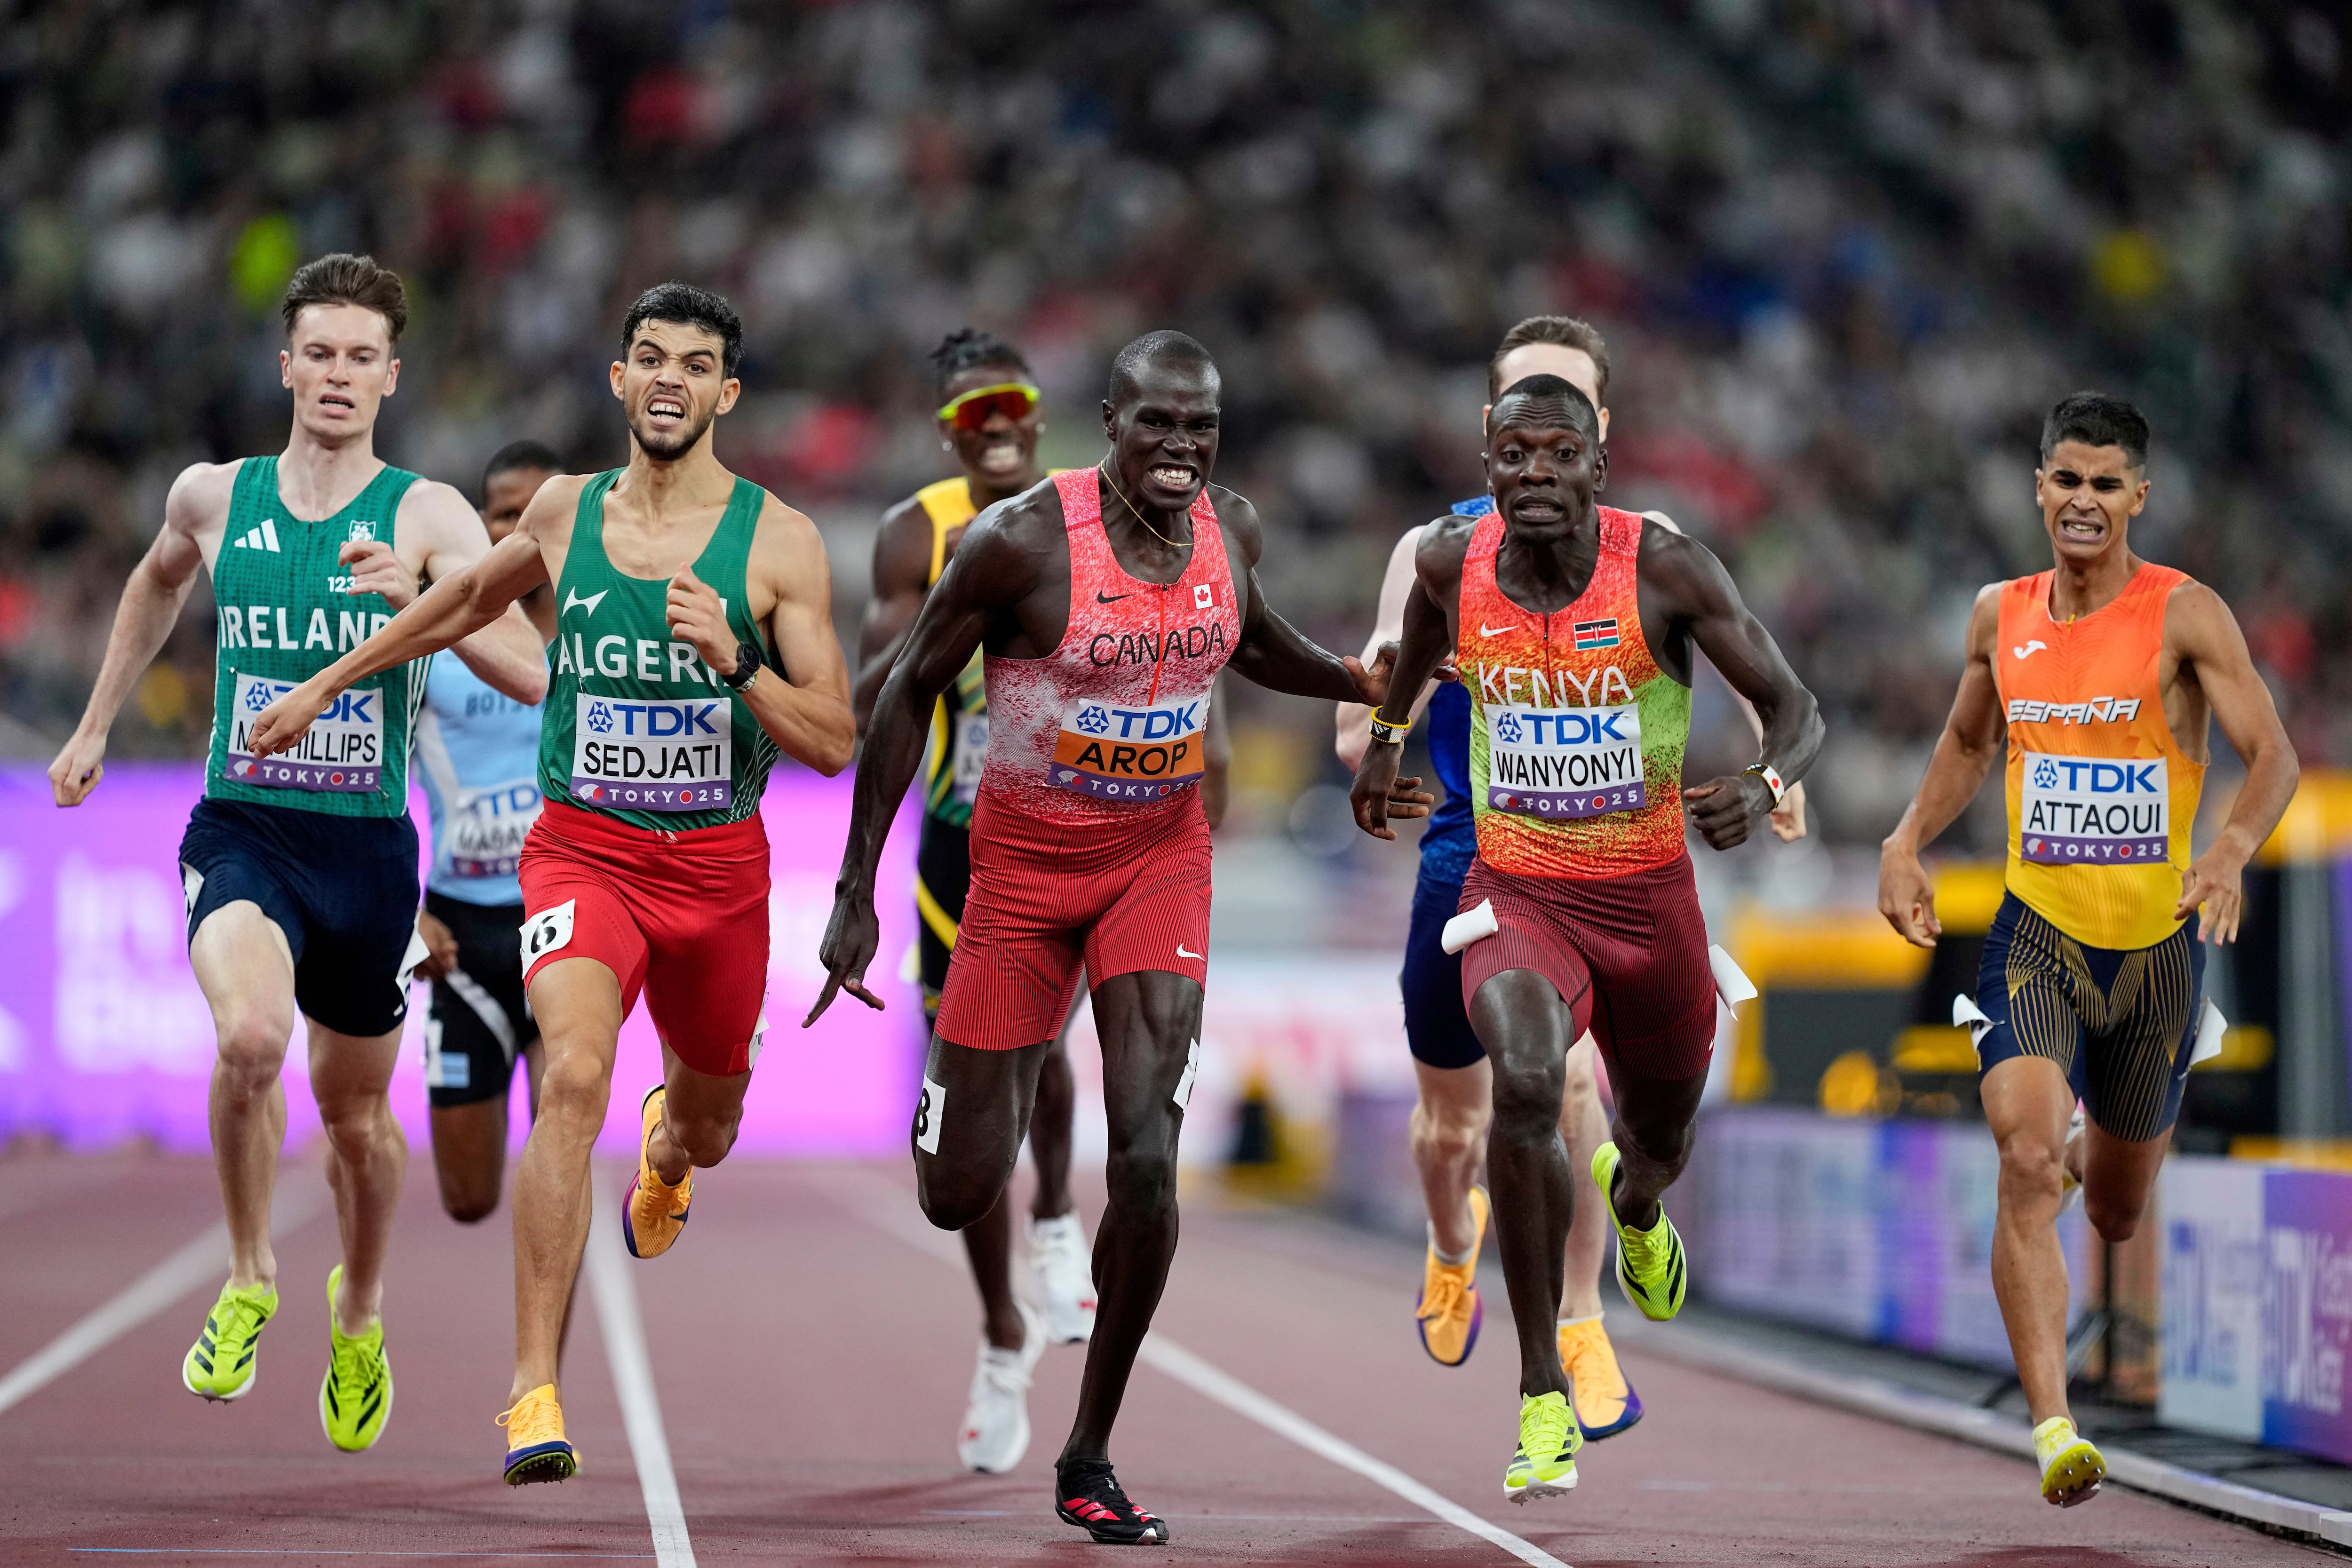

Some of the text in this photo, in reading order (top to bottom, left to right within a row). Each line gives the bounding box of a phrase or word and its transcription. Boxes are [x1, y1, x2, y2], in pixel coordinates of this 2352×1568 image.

[558, 633, 730, 687] ALGERI
[1089, 623, 1224, 667] CANADA
[1478, 661, 1634, 708] KENYA
[613, 704, 718, 736] TDK
[1112, 700, 1199, 740] TDK
[1521, 711, 1628, 745] TDK
[2007, 696, 2141, 725] ESPAÑA
[583, 742, 721, 779] SEDJATI
[1075, 741, 1187, 776] AROP
[1496, 748, 1636, 787] WANYONYI
[2058, 761, 2158, 793] TDK
[2029, 800, 2161, 835] ATTAOUI
[531, 915, 557, 954] 6
